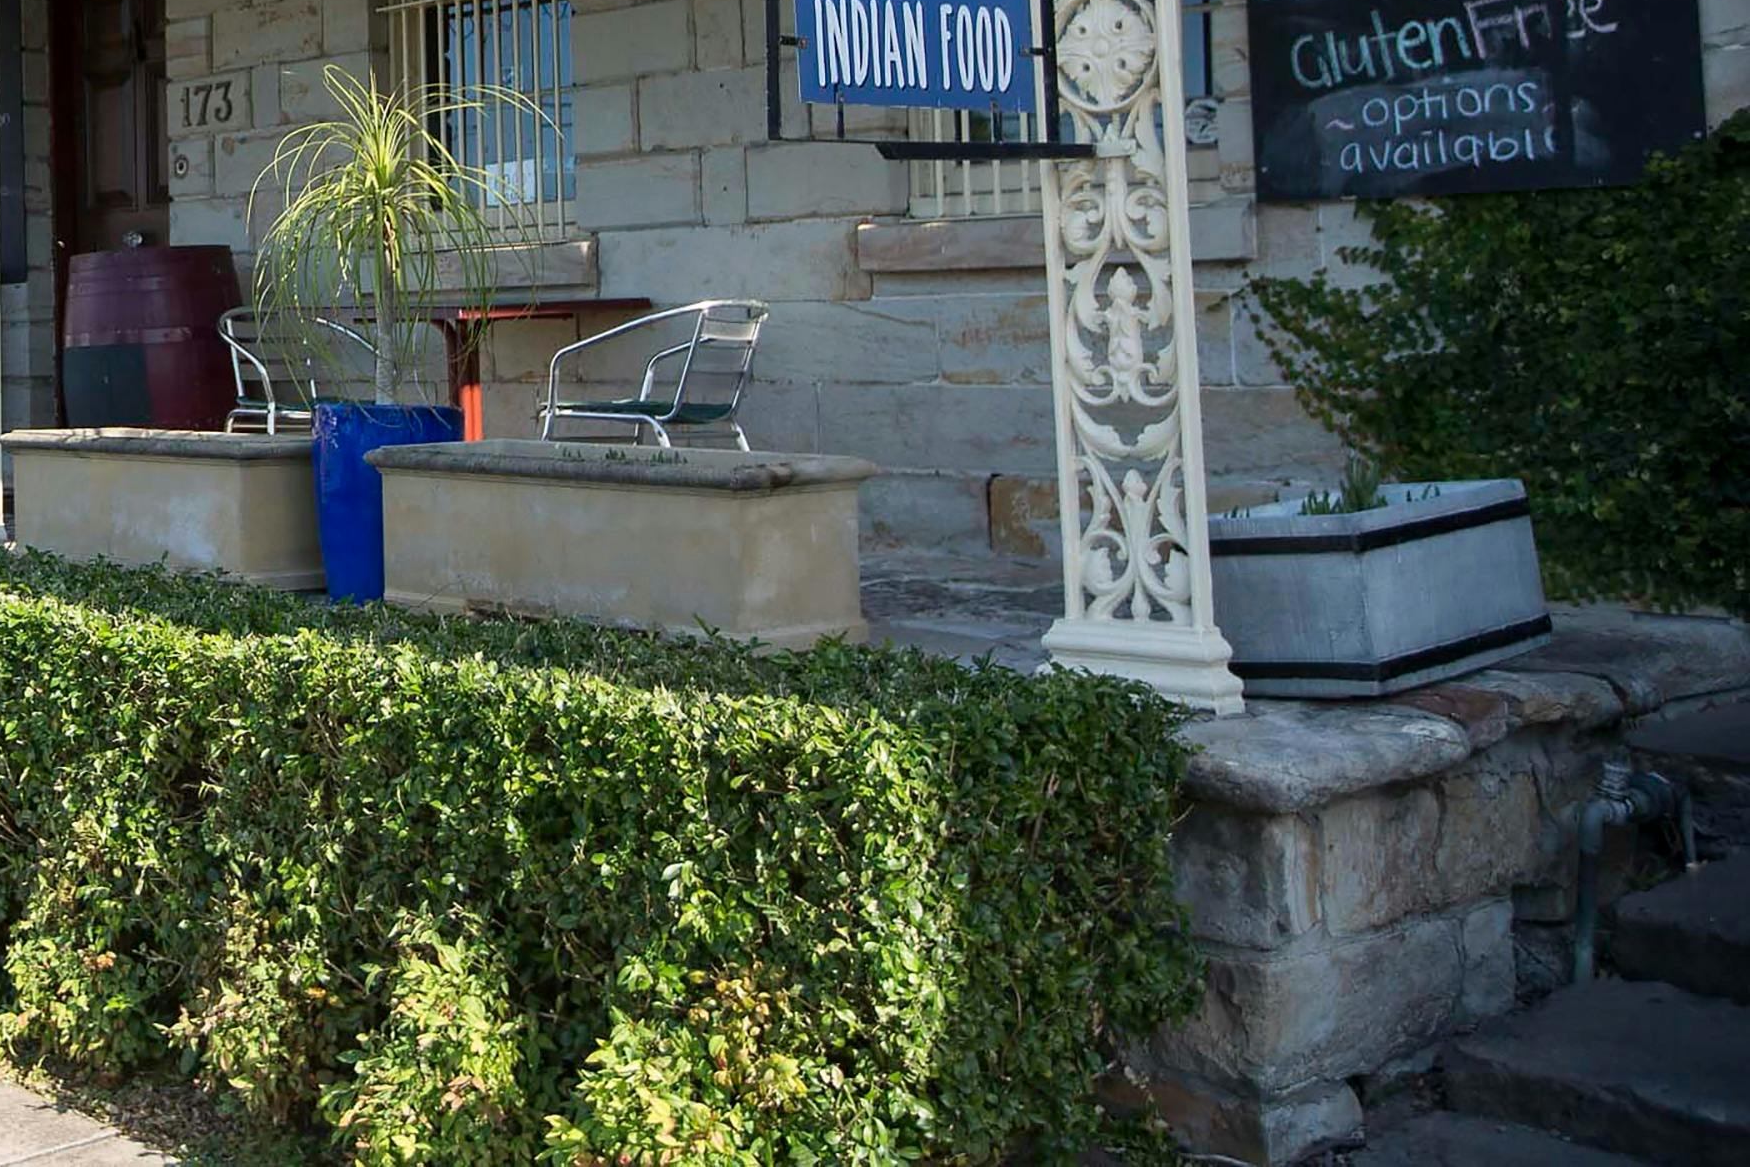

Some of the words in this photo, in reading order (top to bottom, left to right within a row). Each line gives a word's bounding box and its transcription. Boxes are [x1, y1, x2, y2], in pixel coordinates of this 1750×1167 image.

[939, 2, 1014, 93] FOOD
[1290, 9, 1473, 90] Gluten
[179, 80, 233, 127] 173
[1361, 81, 1539, 135] options
